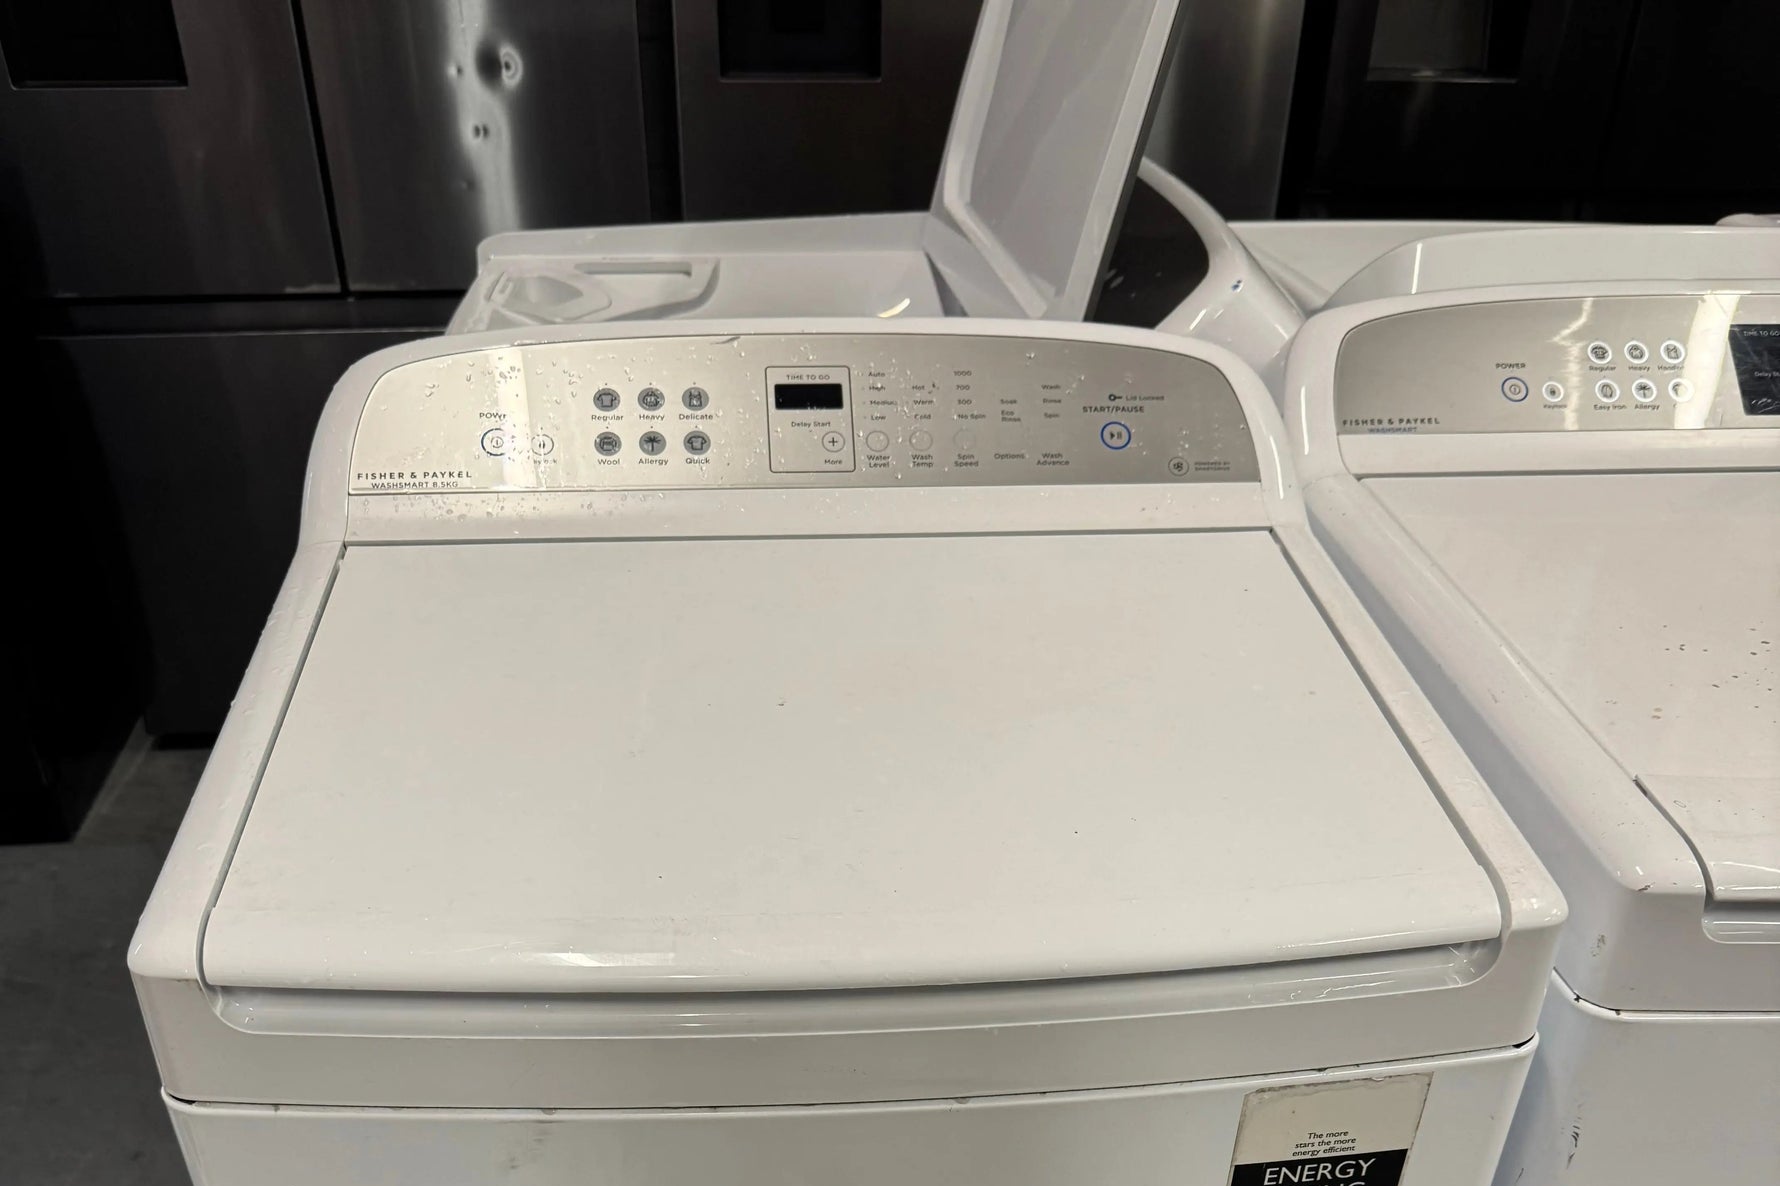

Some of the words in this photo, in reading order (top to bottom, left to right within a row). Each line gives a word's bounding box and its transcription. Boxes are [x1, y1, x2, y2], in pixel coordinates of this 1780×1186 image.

[1082, 405, 1145, 413] START/PAUSE
[1342, 418, 1383, 426] FISHER
[1399, 417, 1440, 425] PAYKEL
[685, 457, 711, 465] Quick
[957, 453, 975, 461] Spin
[638, 458, 669, 466] Allergy
[357, 472, 405, 480] FISHER
[410, 471, 418, 479] &
[423, 470, 473, 479] PAYKEL
[371, 481, 429, 489] WASHSMART
[1307, 1132, 1323, 1140] The
[1295, 1141, 1315, 1149] stars
[1317, 1139, 1332, 1147] the
[1292, 1149, 1321, 1157] energy
[1323, 1145, 1356, 1154] efficient
[1264, 1158, 1376, 1186] ENERGY
